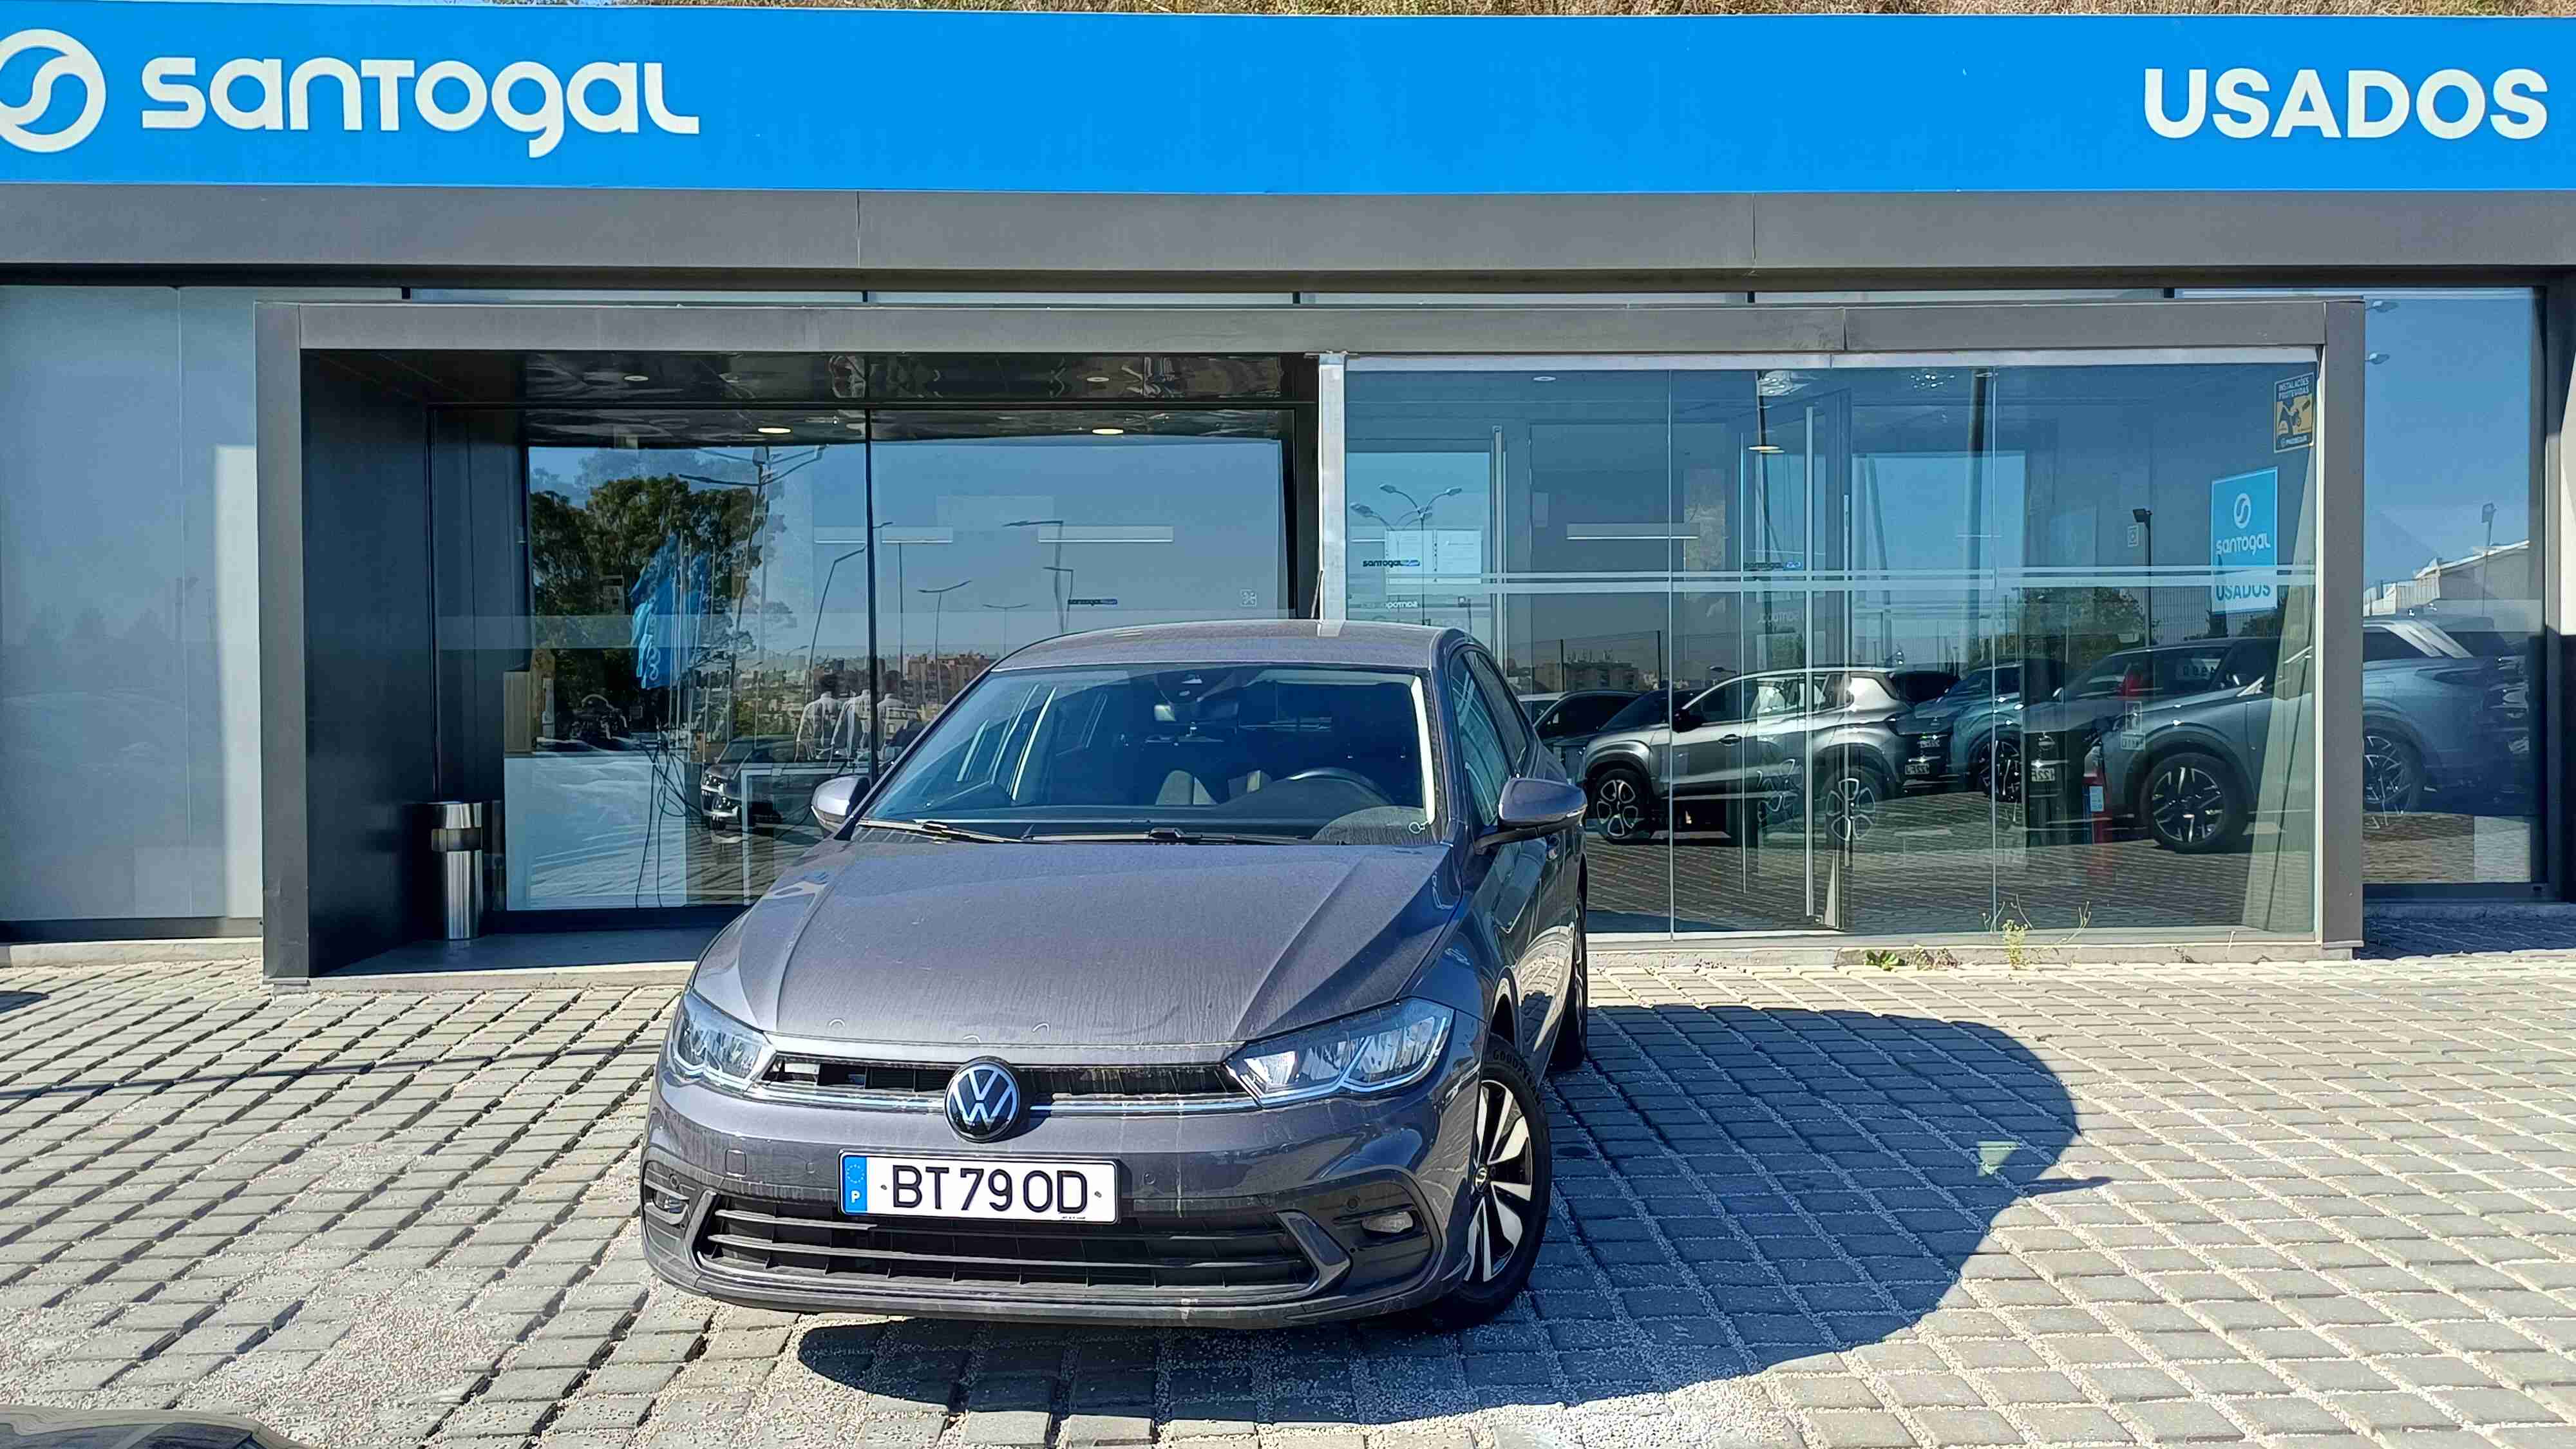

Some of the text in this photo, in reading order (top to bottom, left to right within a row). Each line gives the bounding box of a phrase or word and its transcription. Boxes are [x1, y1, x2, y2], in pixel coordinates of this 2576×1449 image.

[2143, 67, 2549, 140] USADOS
[851, 1189, 862, 1204] P
[893, 1164, 1088, 1214] BT 79 OD
